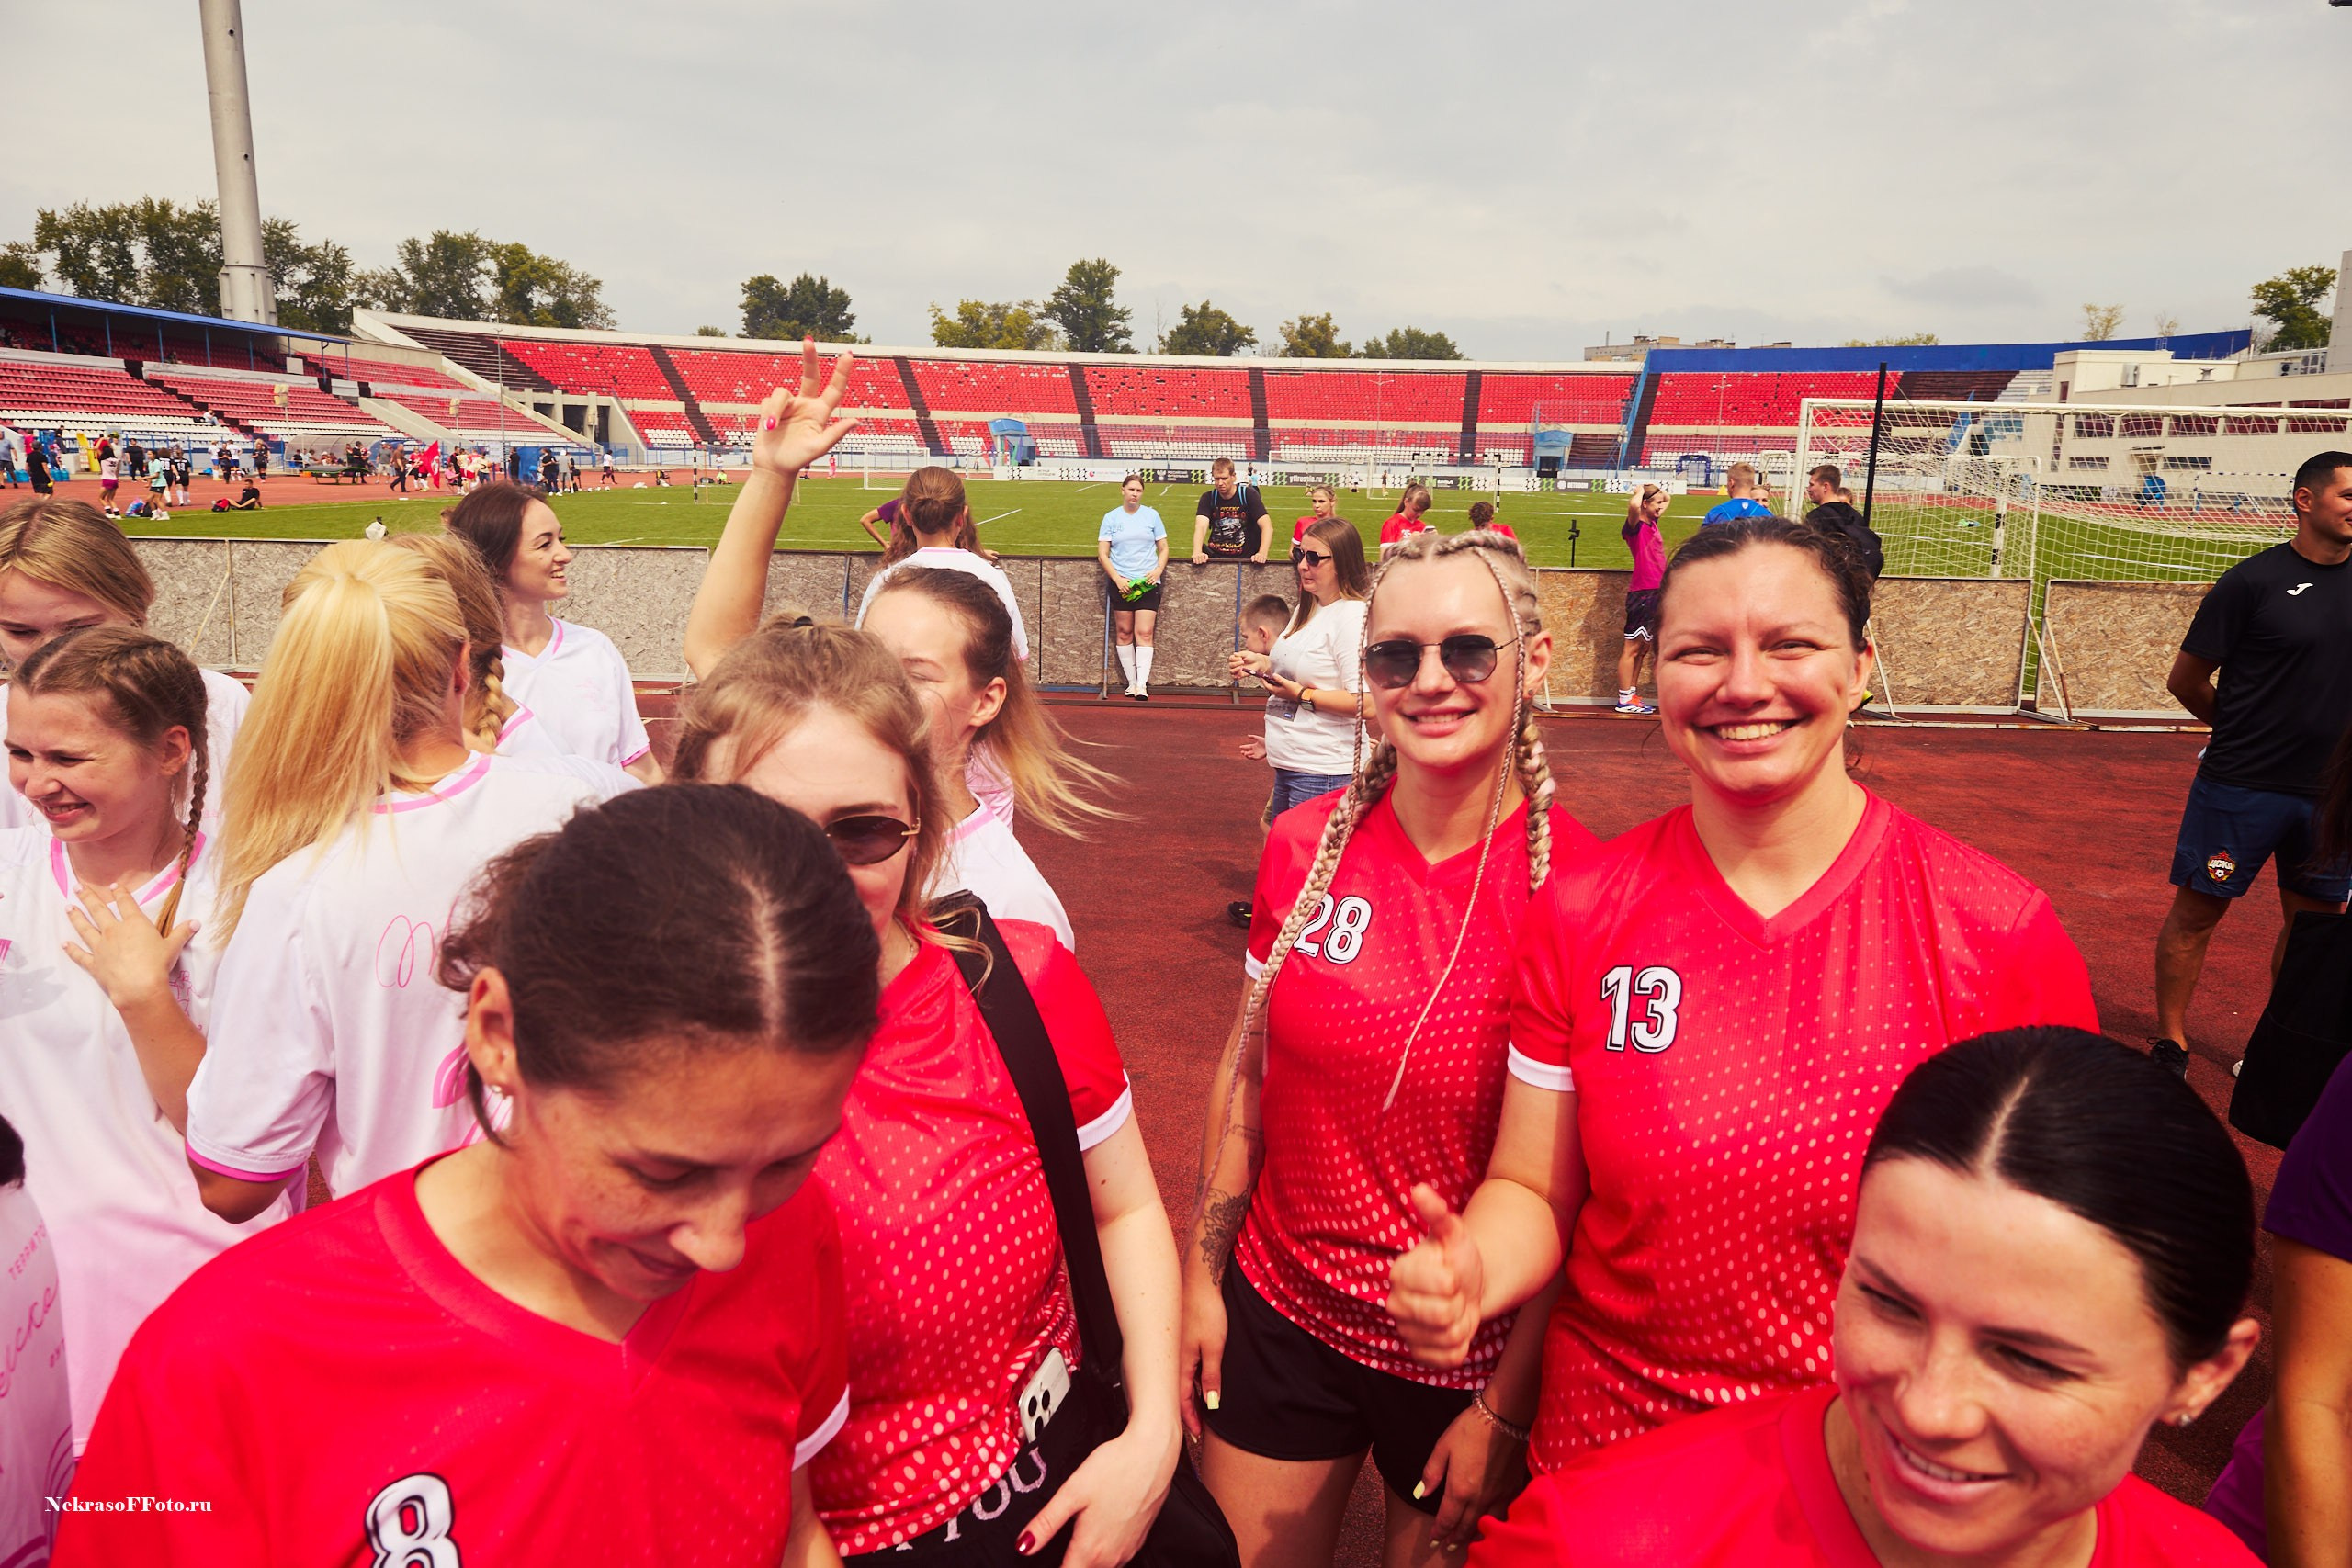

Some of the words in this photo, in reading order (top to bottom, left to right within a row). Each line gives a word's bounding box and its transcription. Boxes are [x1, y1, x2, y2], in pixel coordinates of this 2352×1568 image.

[1294, 892, 1373, 965] 28
[1600, 965, 1683, 1054] 13
[364, 1472, 463, 1568] 8
